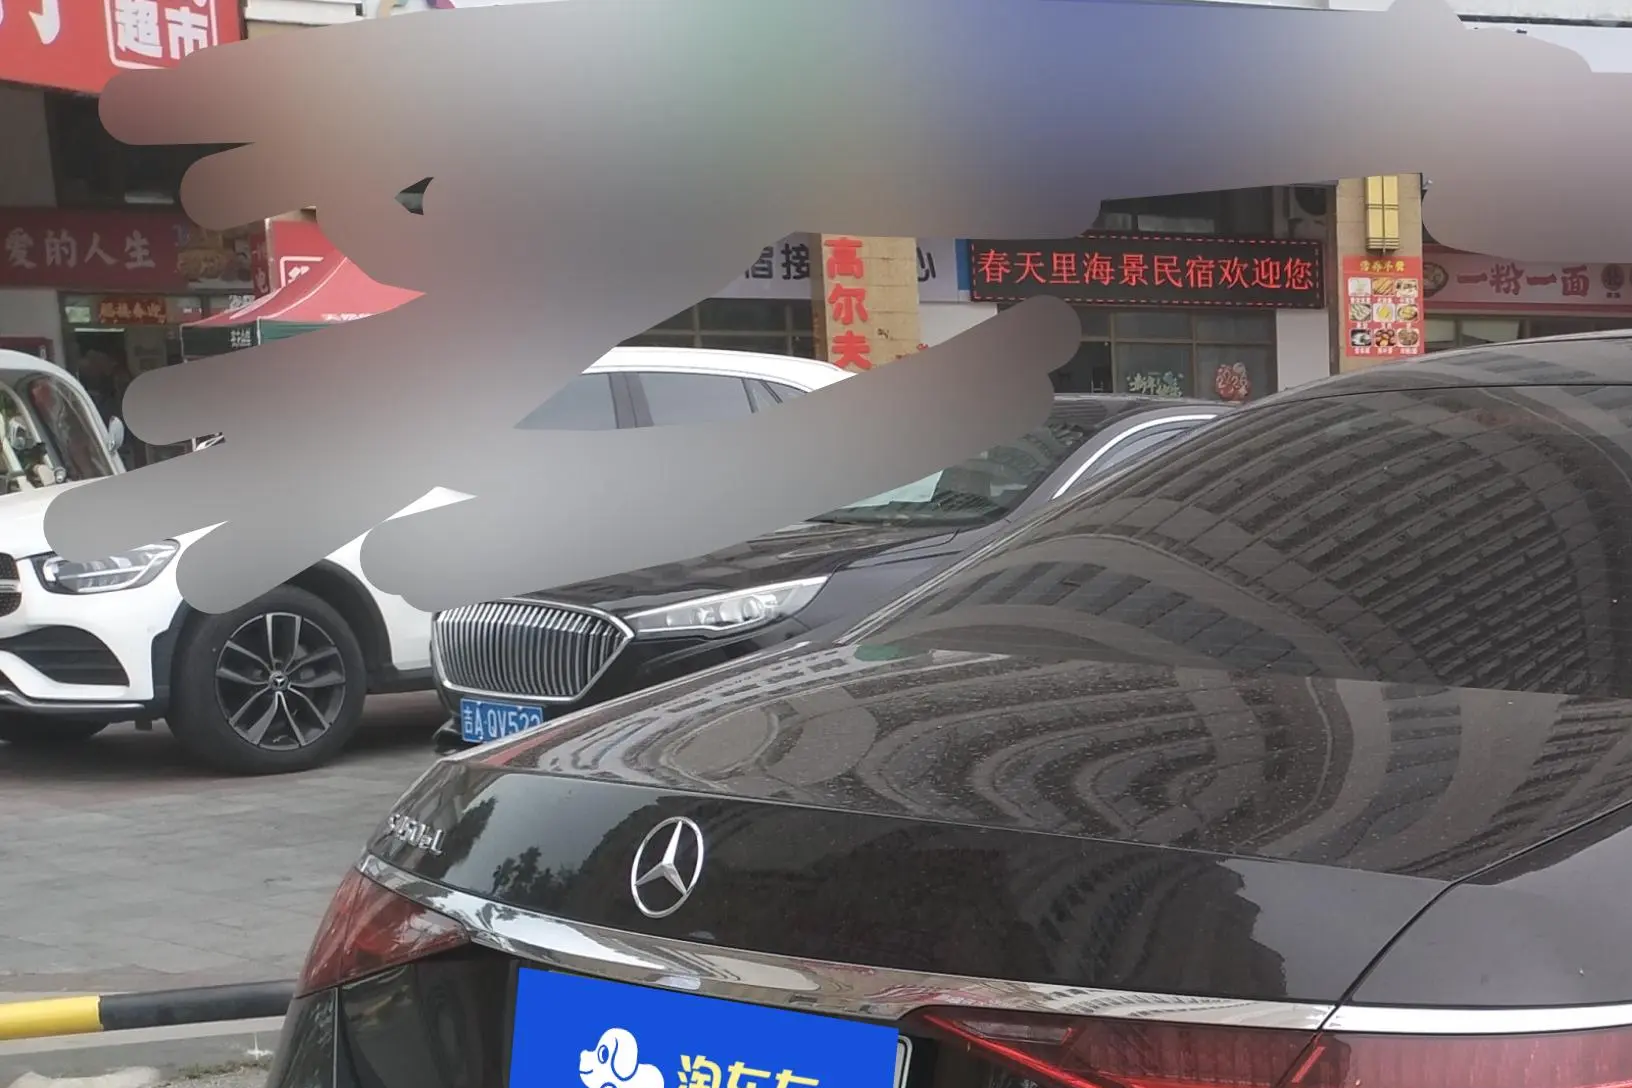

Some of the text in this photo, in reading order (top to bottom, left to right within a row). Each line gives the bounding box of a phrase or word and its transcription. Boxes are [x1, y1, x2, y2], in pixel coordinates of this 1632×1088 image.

[115, 0, 208, 60] 超市
[977, 249, 1313, 290] 春天里海景民宿欢迎您
[1456, 262, 1590, 297] 一粉一面
[824, 237, 872, 370] 高尔夫
